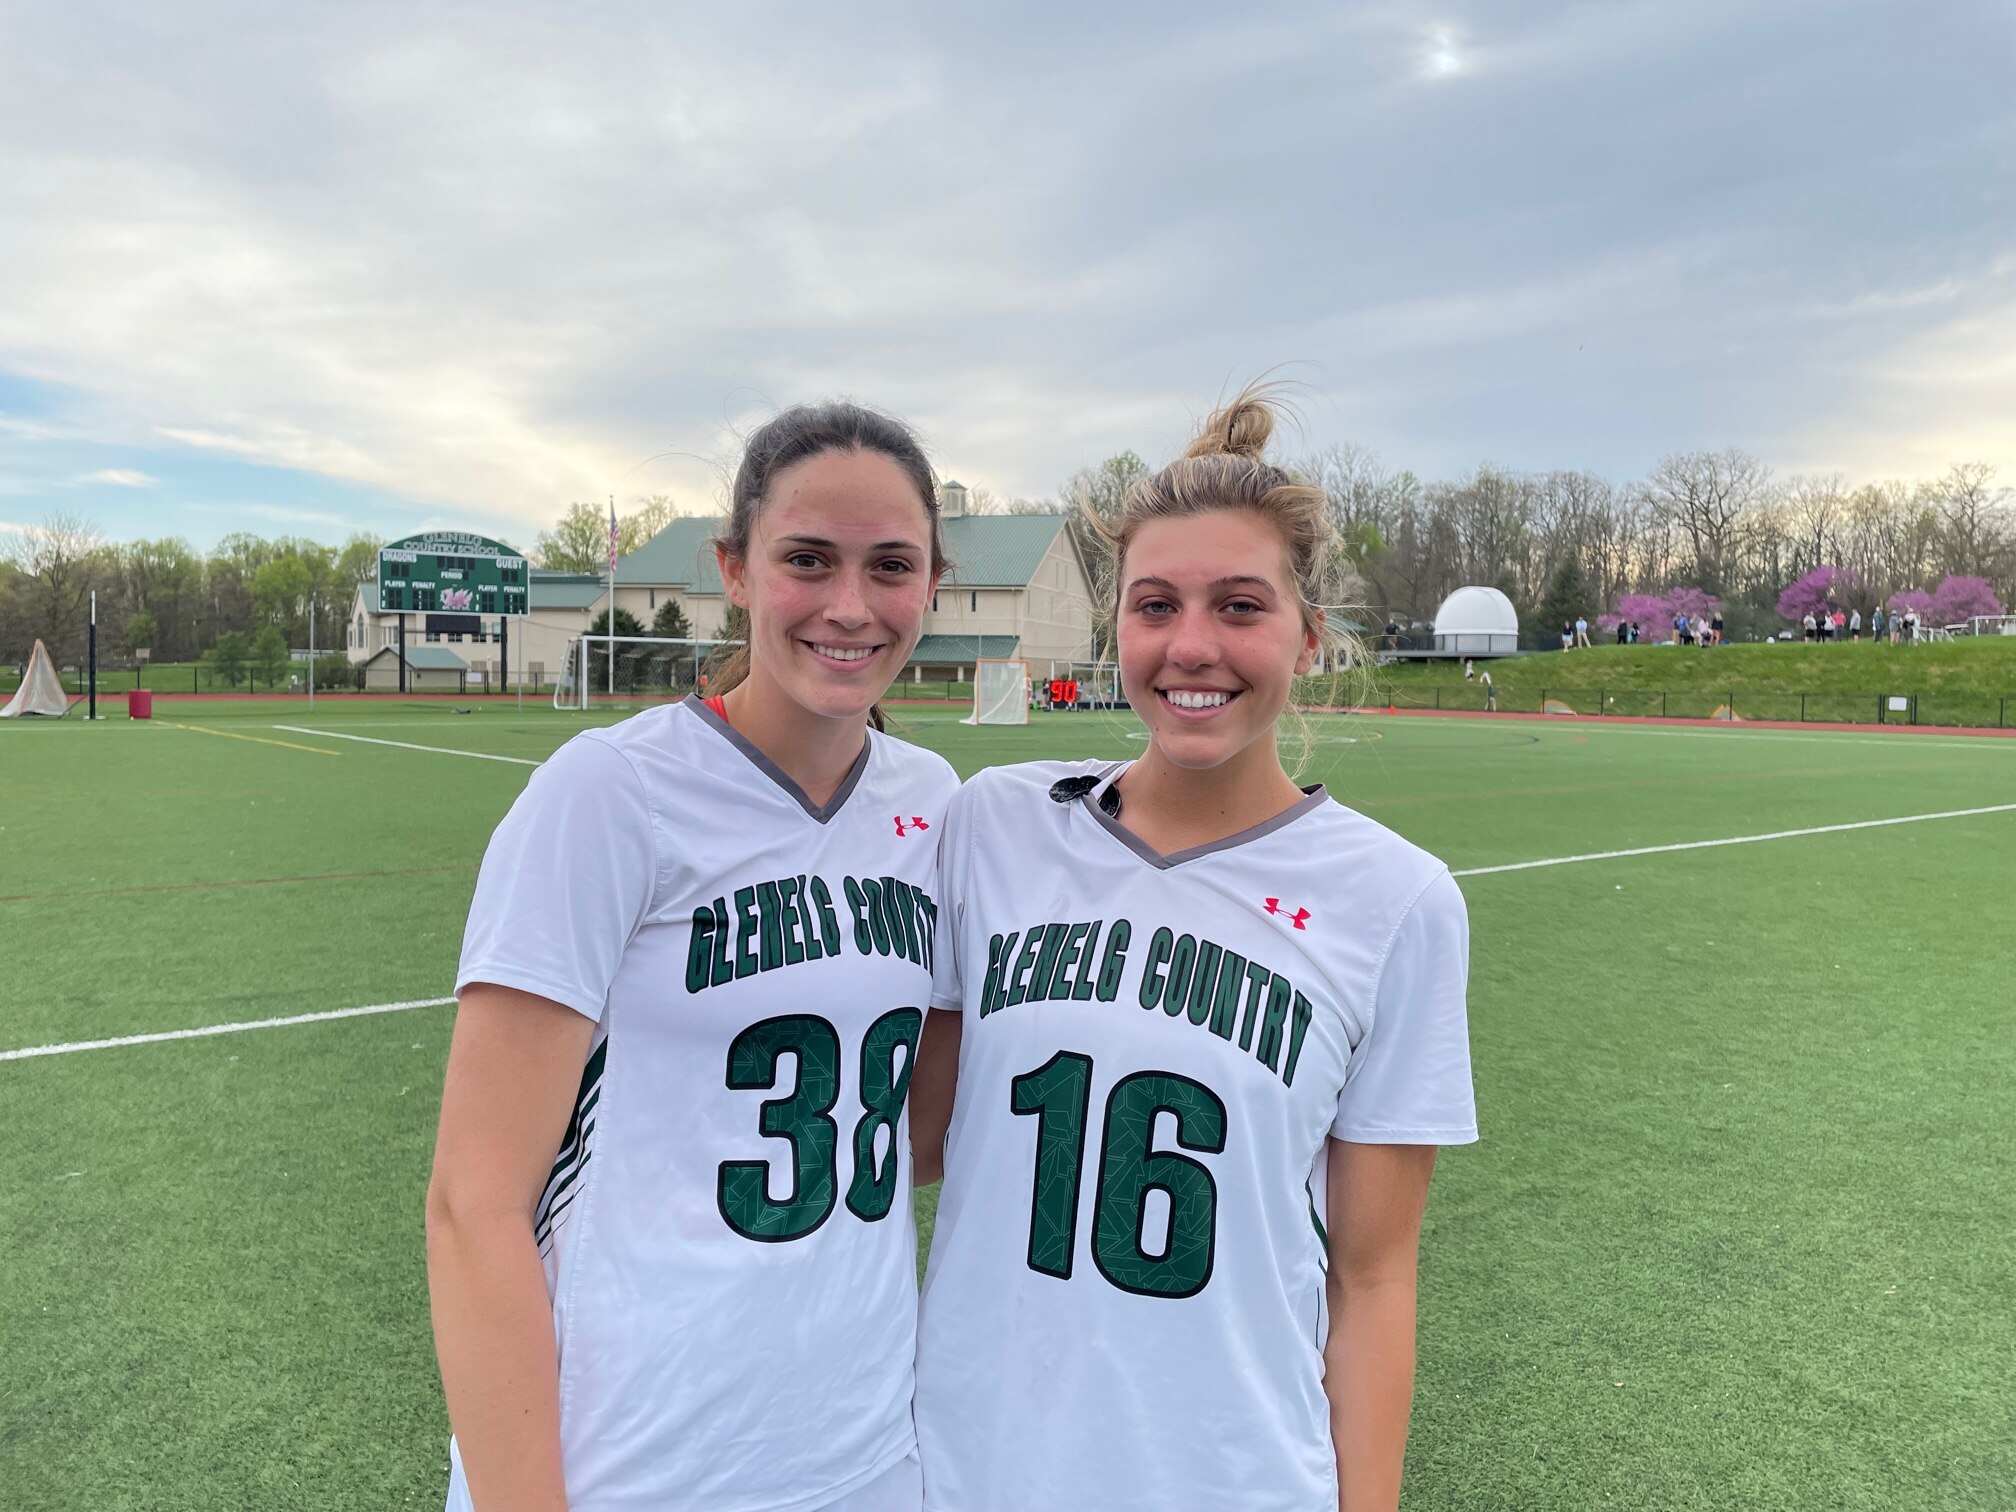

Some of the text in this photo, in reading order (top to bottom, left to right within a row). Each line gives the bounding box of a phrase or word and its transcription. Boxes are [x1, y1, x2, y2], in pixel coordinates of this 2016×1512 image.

[422, 532, 482, 546] GLENELG
[403, 541, 500, 556] COUNTRY SCHOOL
[382, 551, 417, 563] DRAGONS
[496, 558, 523, 569] GUEST
[441, 571, 463, 579] PERIOD
[412, 581, 436, 589] PENALTY
[478, 584, 498, 592] PLAYER
[1051, 680, 1077, 702] 90
[685, 874, 842, 994] GLENELG
[980, 918, 1313, 1088] GLENELG COUNTRY
[717, 1006, 923, 1244] 38
[1010, 1049, 1228, 1300] 16
